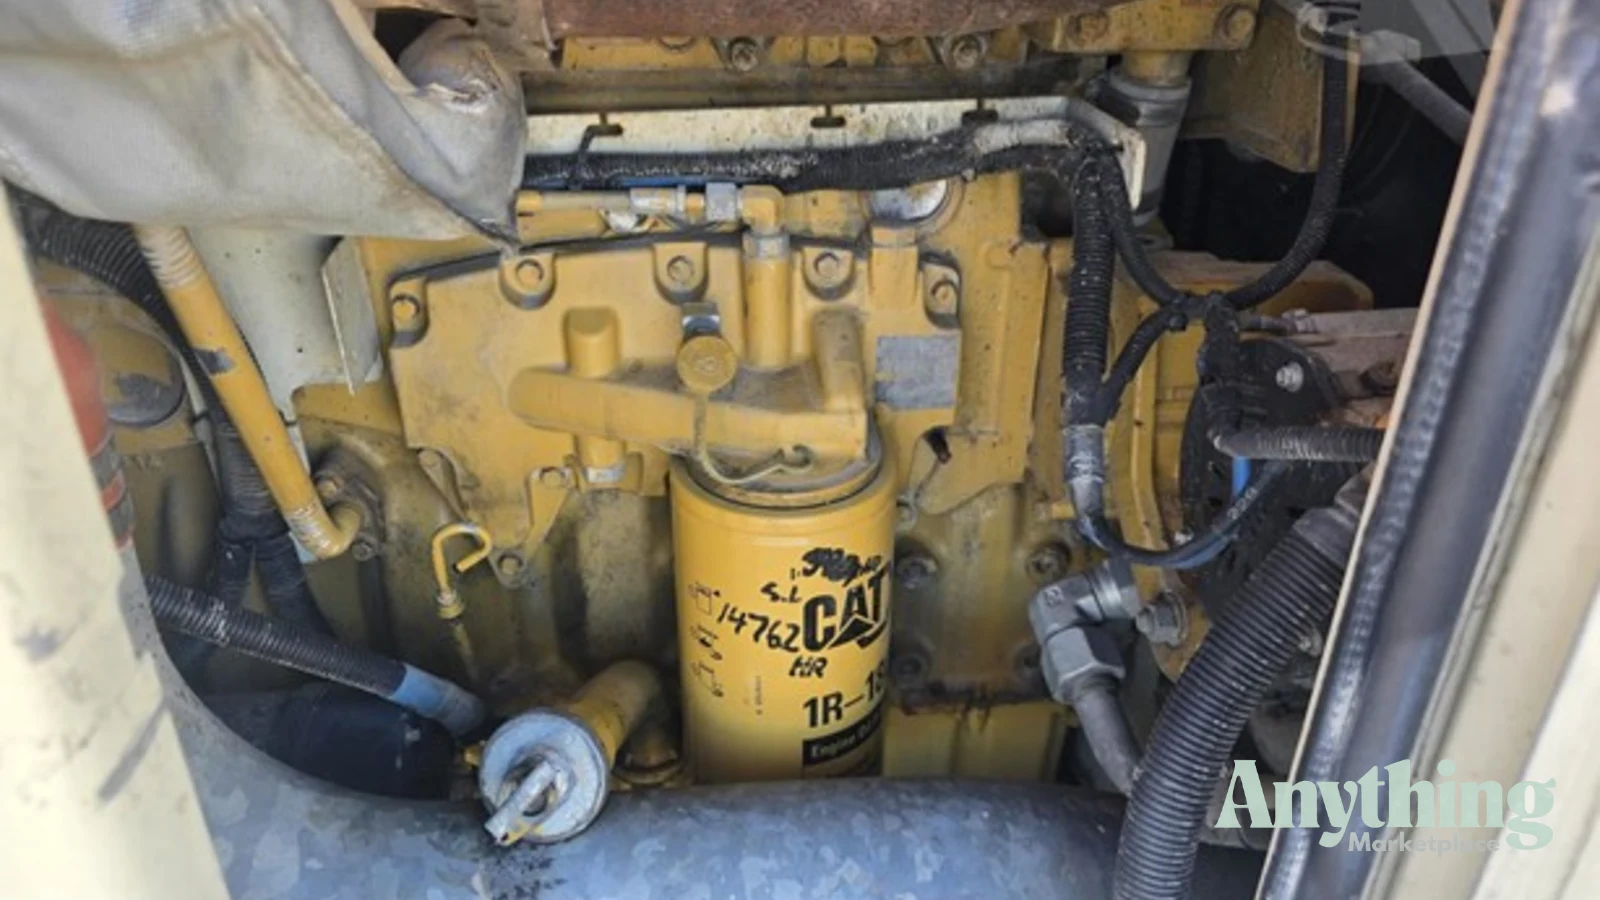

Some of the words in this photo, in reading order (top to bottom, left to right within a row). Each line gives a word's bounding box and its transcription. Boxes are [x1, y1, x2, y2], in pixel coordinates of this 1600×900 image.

[717, 602, 800, 653] 14762
[803, 561, 892, 652] CAT
[790, 656, 828, 678] HR
